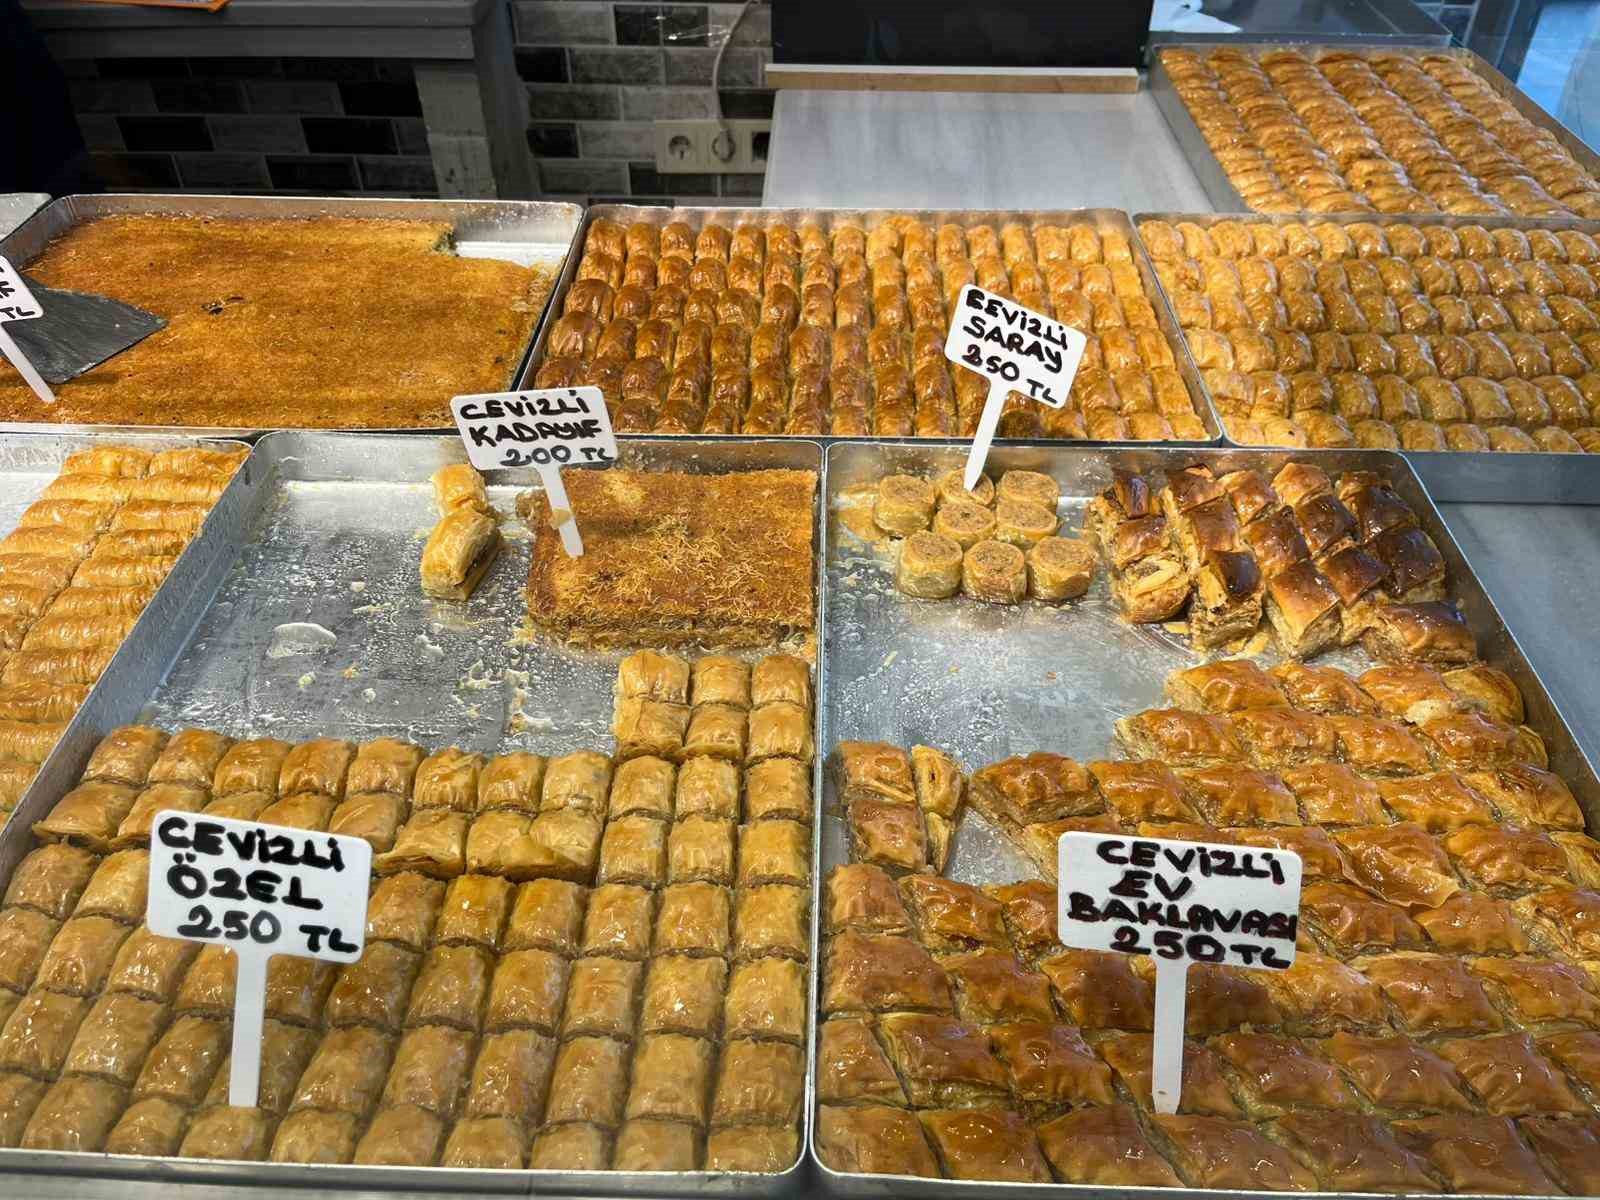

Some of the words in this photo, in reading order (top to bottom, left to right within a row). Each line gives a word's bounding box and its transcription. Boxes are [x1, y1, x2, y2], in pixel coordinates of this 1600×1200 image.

[962, 315, 1063, 374] SARAY
[962, 344, 1020, 382] 250
[1026, 378, 1058, 404] TL
[500, 445, 572, 467] 200
[579, 447, 614, 463] TL
[166, 852, 324, 911] ÖZEL
[1108, 870, 1193, 902] EV
[177, 904, 282, 944] 250
[298, 924, 359, 953] TL
[1067, 891, 1298, 942] BAKLAVASI
[1110, 925, 1226, 963] 250
[1230, 943, 1291, 970] TL
